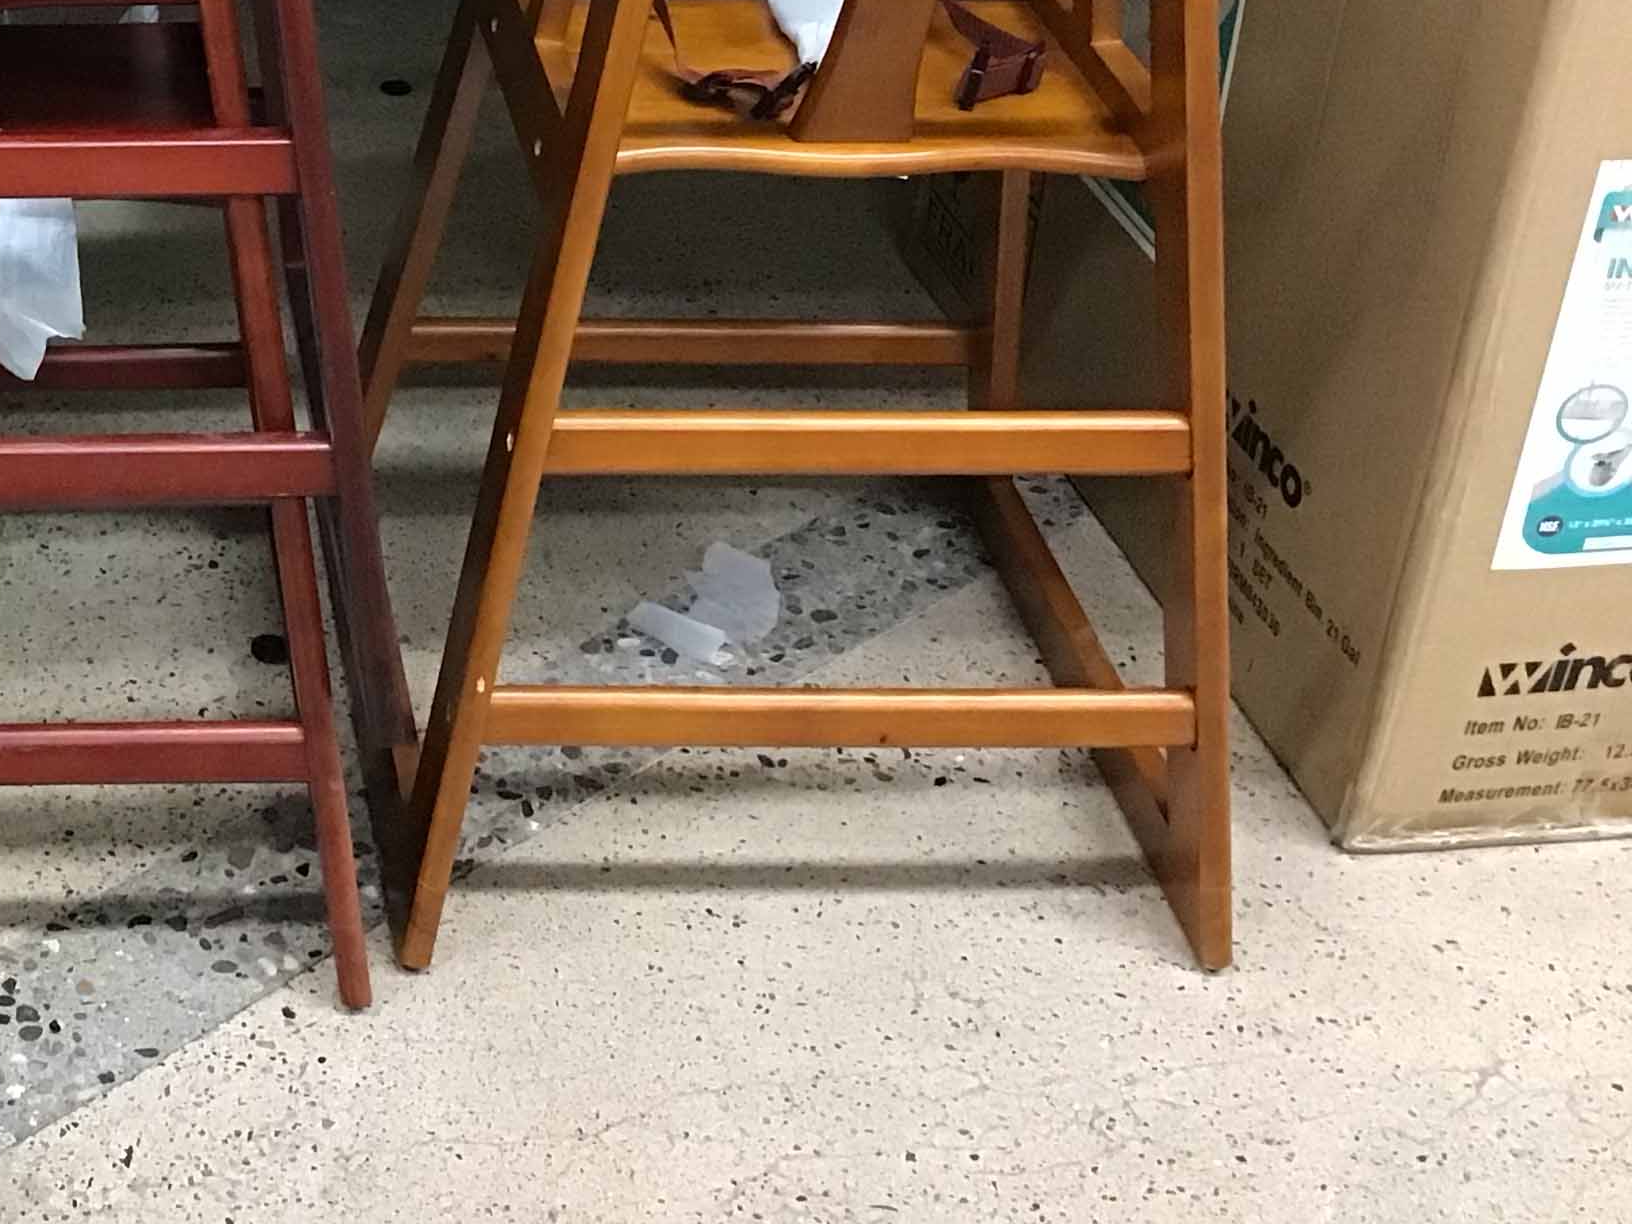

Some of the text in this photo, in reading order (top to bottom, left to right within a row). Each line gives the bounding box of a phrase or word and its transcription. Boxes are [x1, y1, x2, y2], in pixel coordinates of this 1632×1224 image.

[1226, 398, 1303, 509] inco
[1477, 642, 1632, 698] Winc
[1463, 719, 1505, 736] Item
[1451, 754, 1507, 771] Gross
[1516, 746, 1584, 766] Weight:
